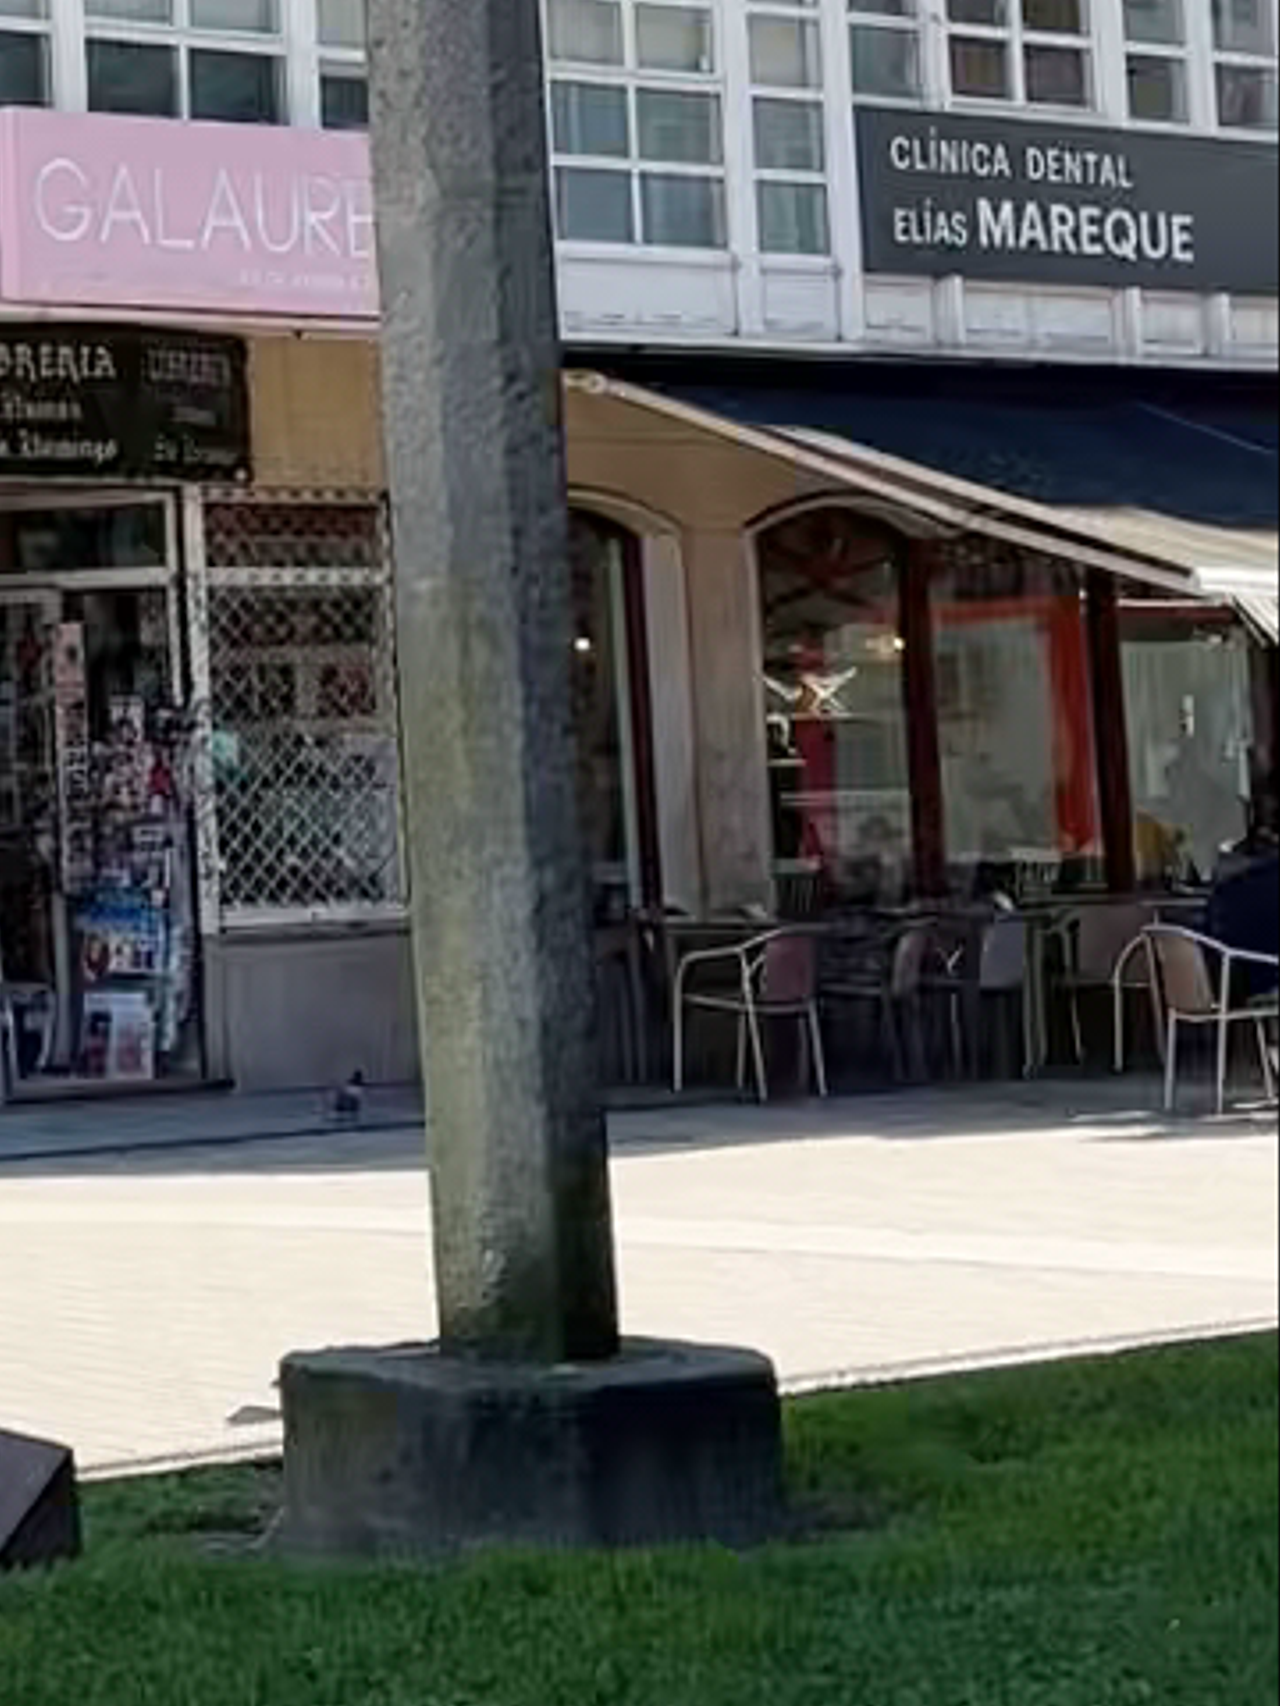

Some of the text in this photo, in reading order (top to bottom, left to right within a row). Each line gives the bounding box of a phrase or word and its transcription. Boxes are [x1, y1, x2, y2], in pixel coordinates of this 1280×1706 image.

[889, 126, 1134, 189] CLÍNICA DENTAL
[893, 196, 1195, 263] ELÍAS MAREQUE
